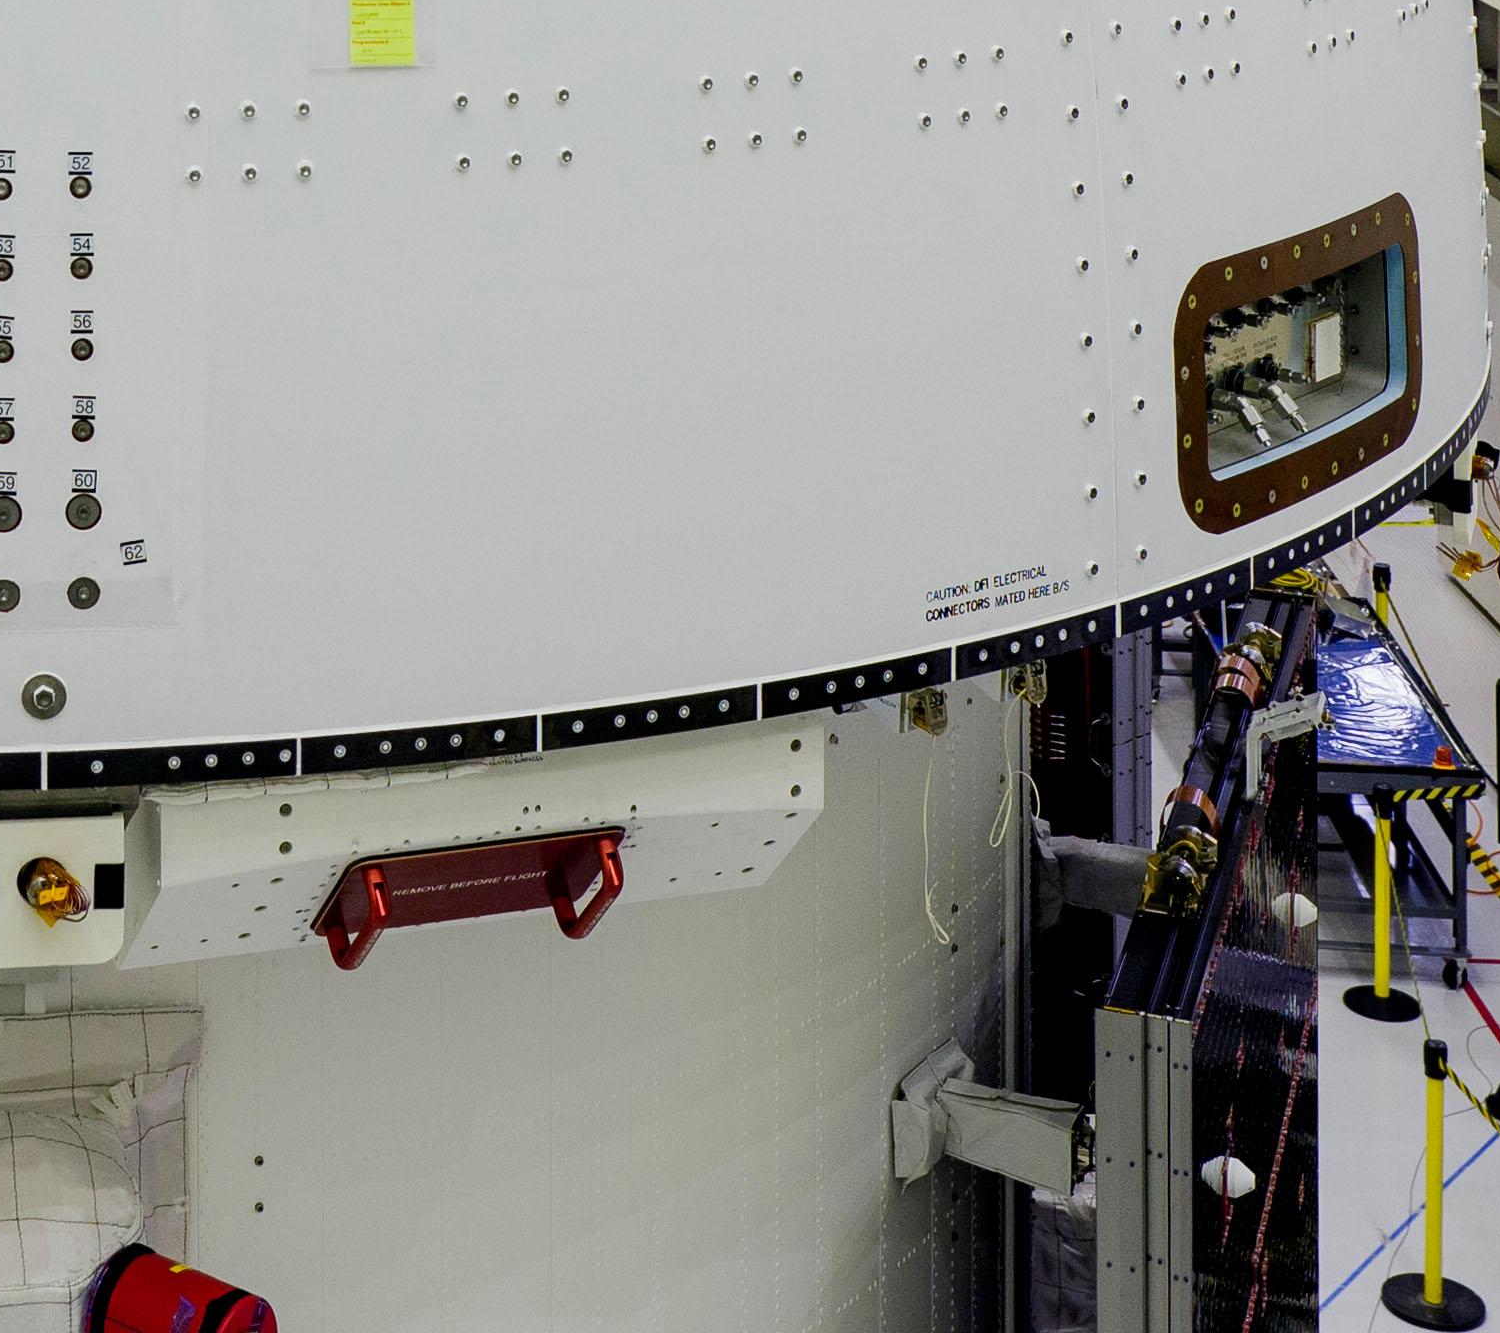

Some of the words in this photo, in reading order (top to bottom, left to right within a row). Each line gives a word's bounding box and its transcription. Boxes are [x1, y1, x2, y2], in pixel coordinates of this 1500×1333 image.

[72, 156, 90, 170] 52
[73, 237, 91, 251] 54
[73, 314, 92, 329] 56
[75, 400, 94, 414] 58
[74, 473, 93, 487] 60
[124, 545, 143, 561] 62
[993, 565, 1047, 587] ELECTRICAL
[925, 597, 990, 622] CONNECTORS
[994, 590, 1025, 608] MATED
[1028, 584, 1050, 600] HERE
[392, 884, 447, 896] REMOVE
[449, 876, 502, 890] BEFORE
[504, 870, 549, 882] FLIGHT
